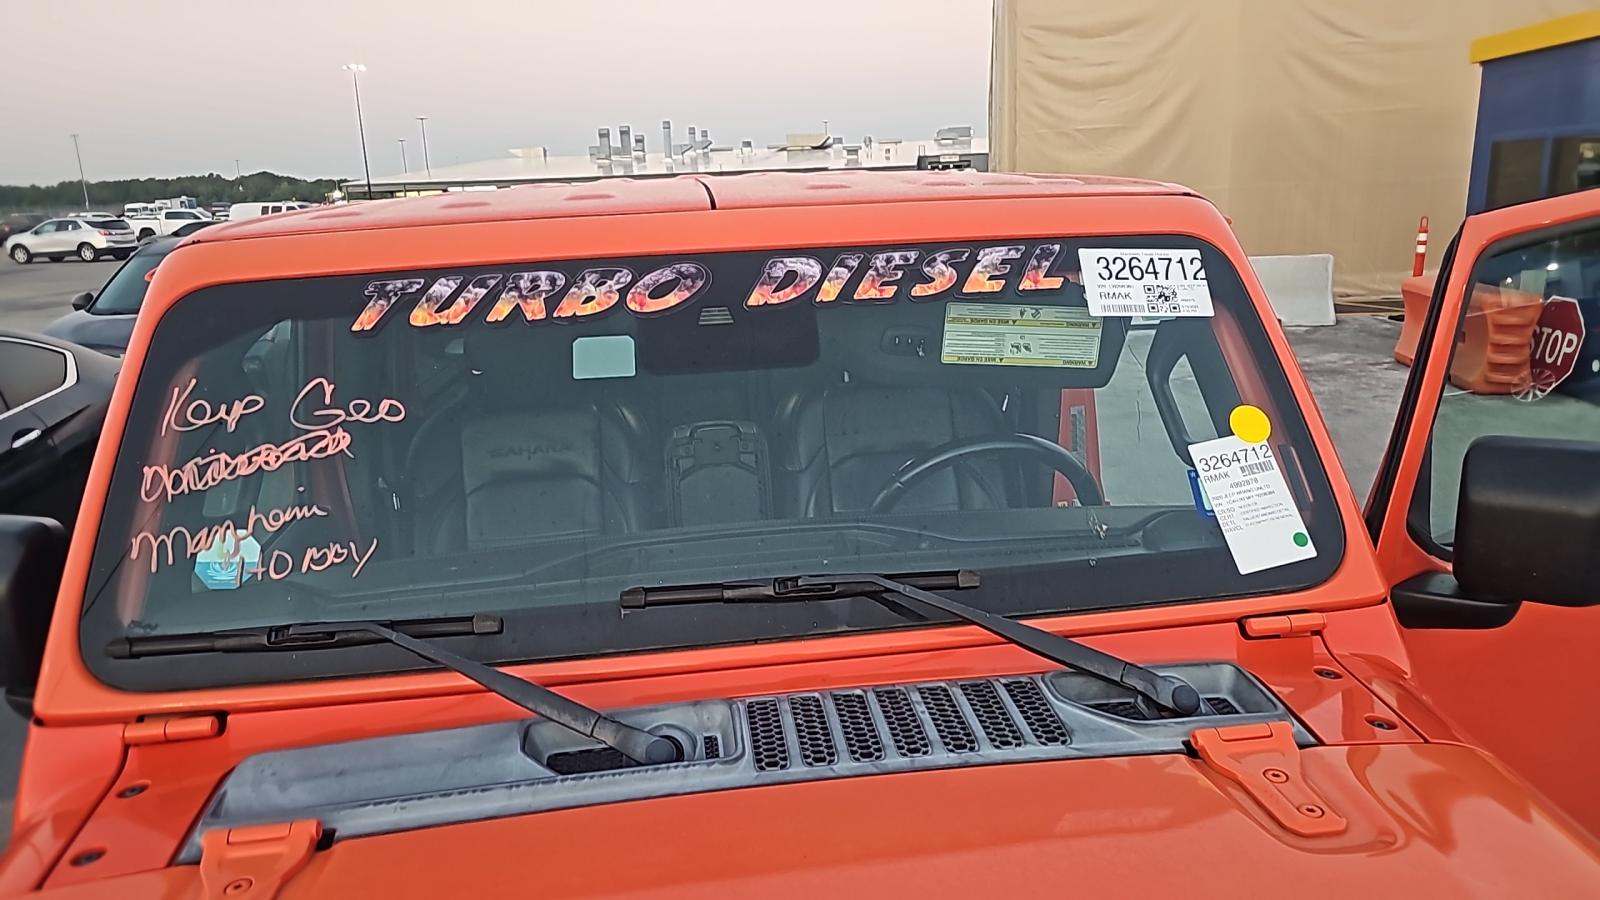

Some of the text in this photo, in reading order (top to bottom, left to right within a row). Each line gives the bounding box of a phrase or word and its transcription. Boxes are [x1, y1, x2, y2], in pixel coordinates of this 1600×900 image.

[1096, 256, 1208, 281] 3264712
[351, 244, 1065, 332] TURBO DIESEL
[1099, 291, 1132, 301] RMAK
[1199, 444, 1273, 473] 3264712
[1203, 471, 1231, 485] RMAK
